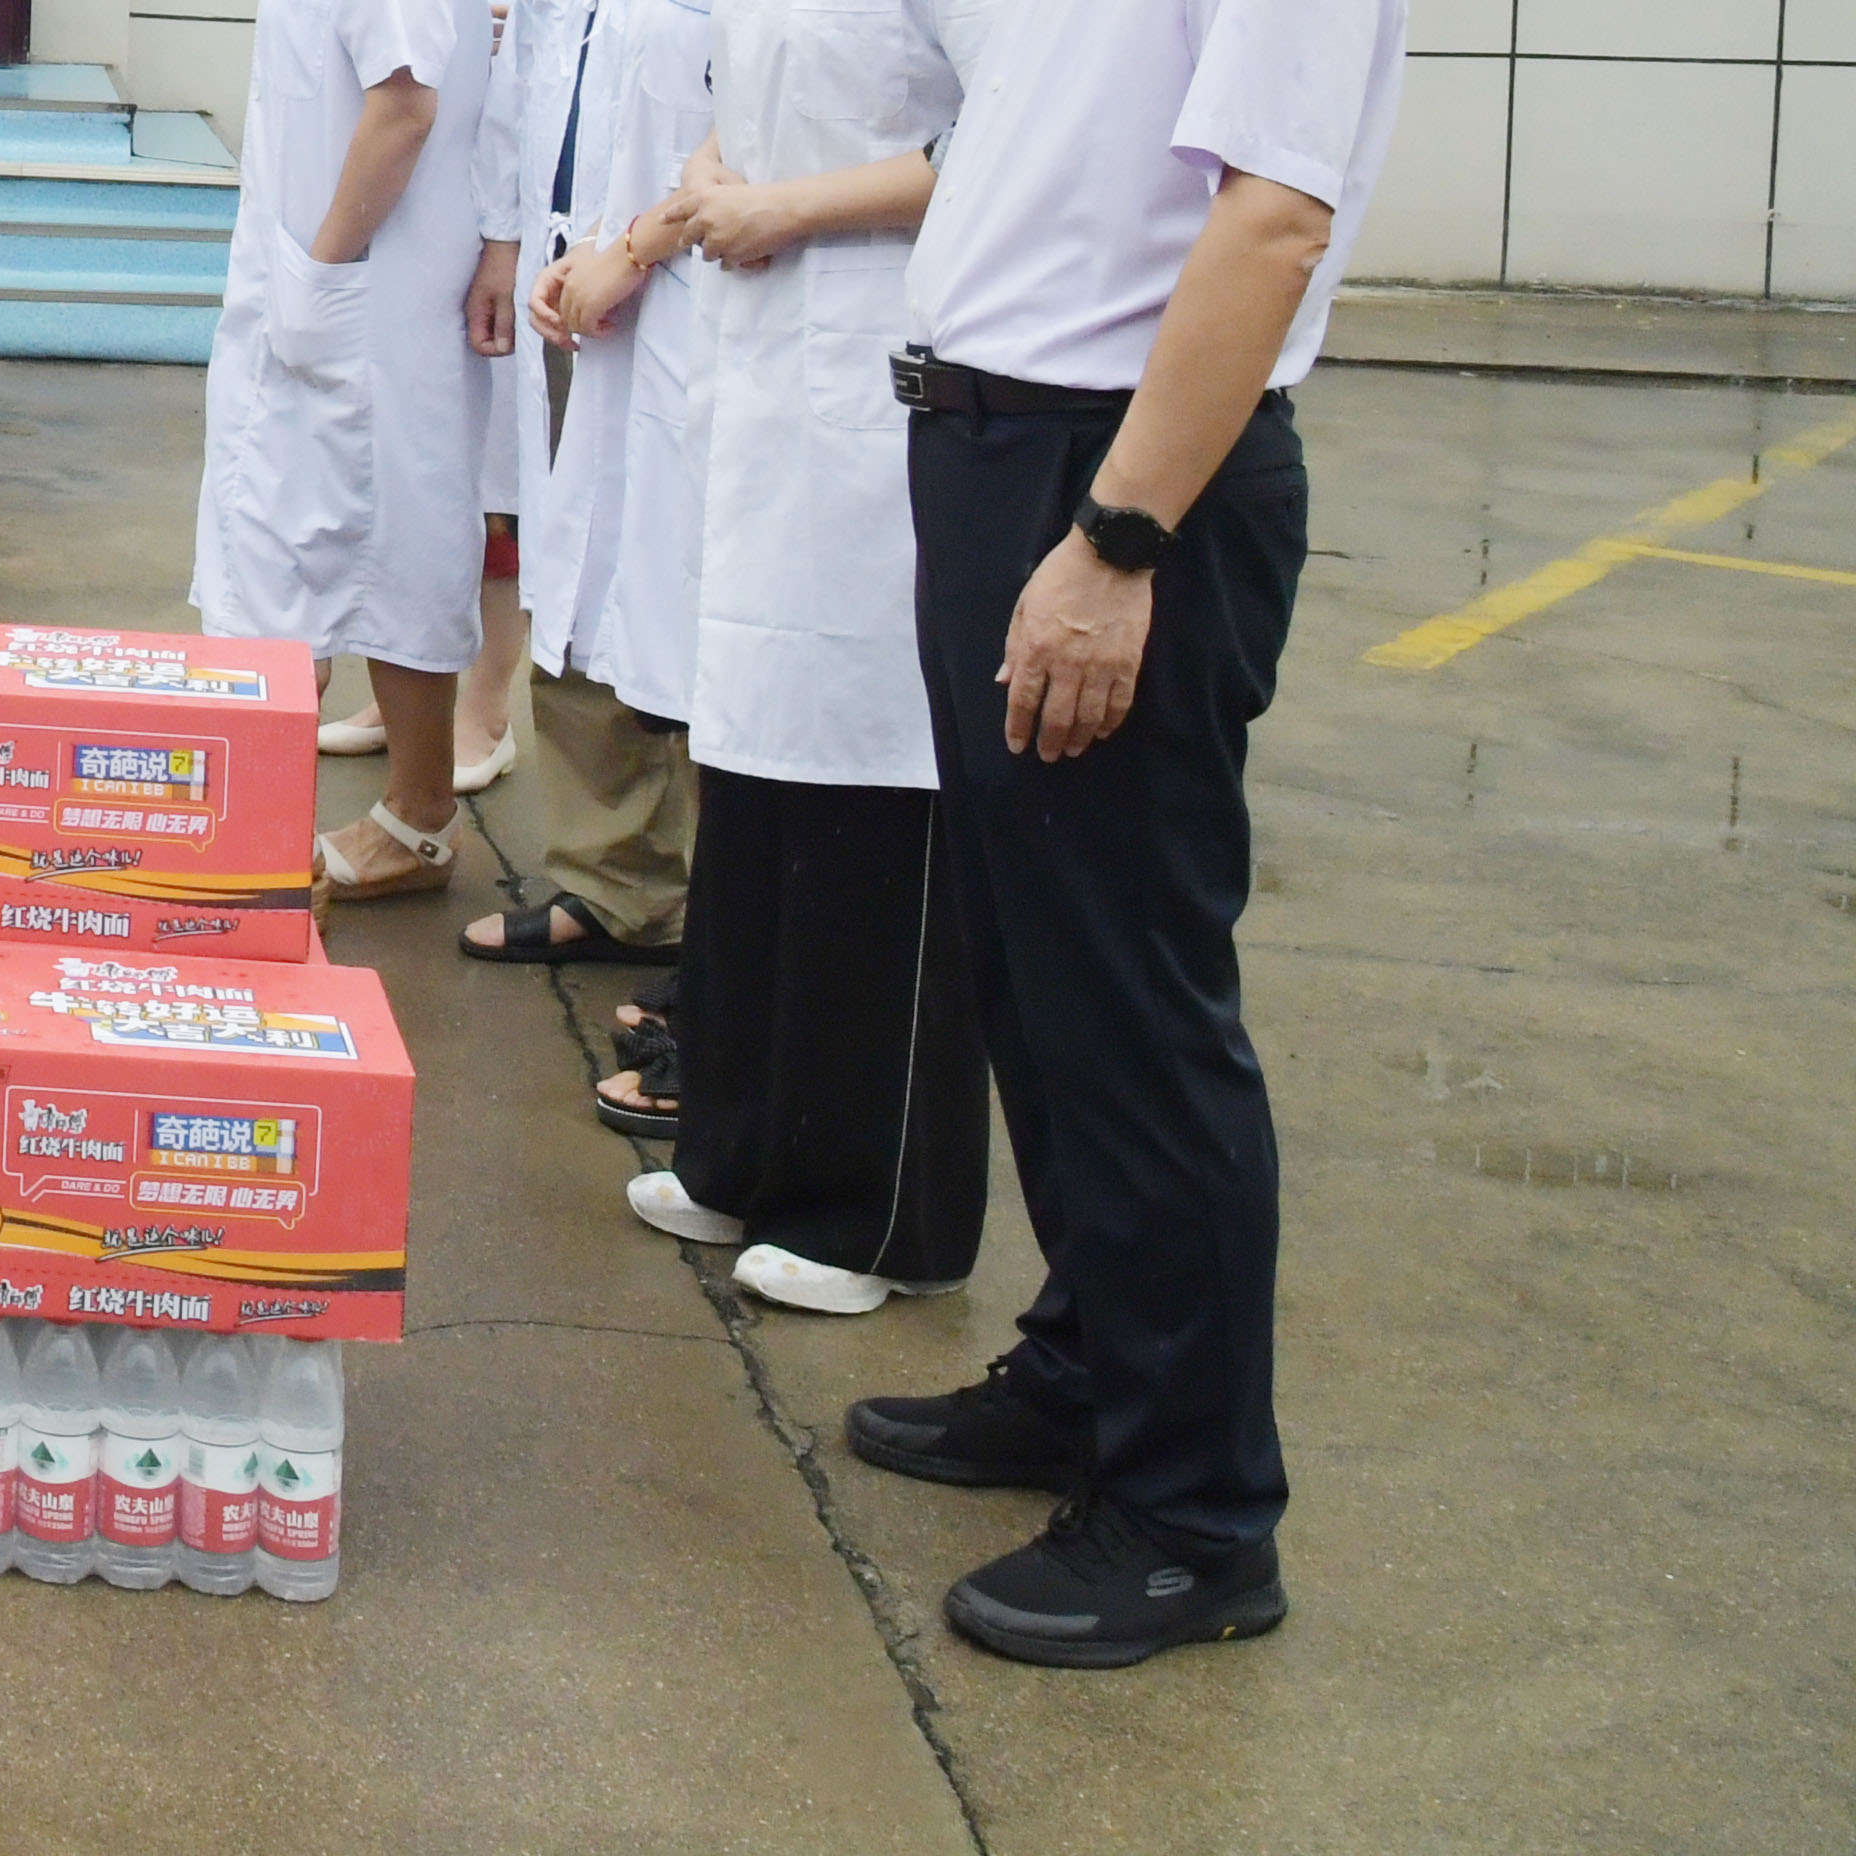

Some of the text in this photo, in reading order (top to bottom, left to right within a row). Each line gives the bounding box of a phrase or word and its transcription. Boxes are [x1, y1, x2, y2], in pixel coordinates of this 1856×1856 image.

[79, 748, 169, 782] 奇葩说
[60, 806, 208, 835] 梦想无限 心无界
[0, 904, 131, 938] 红烧牛肉面
[59, 977, 254, 1002] 红烧牛肉面
[19, 1135, 125, 1163] 红烧牛肉面
[157, 1116, 252, 1153] 奇葩说
[137, 1181, 298, 1211] 梦想无限 心无界
[68, 1285, 212, 1322] 红烧牛肉面
[114, 1494, 174, 1515] 农夫山泉
